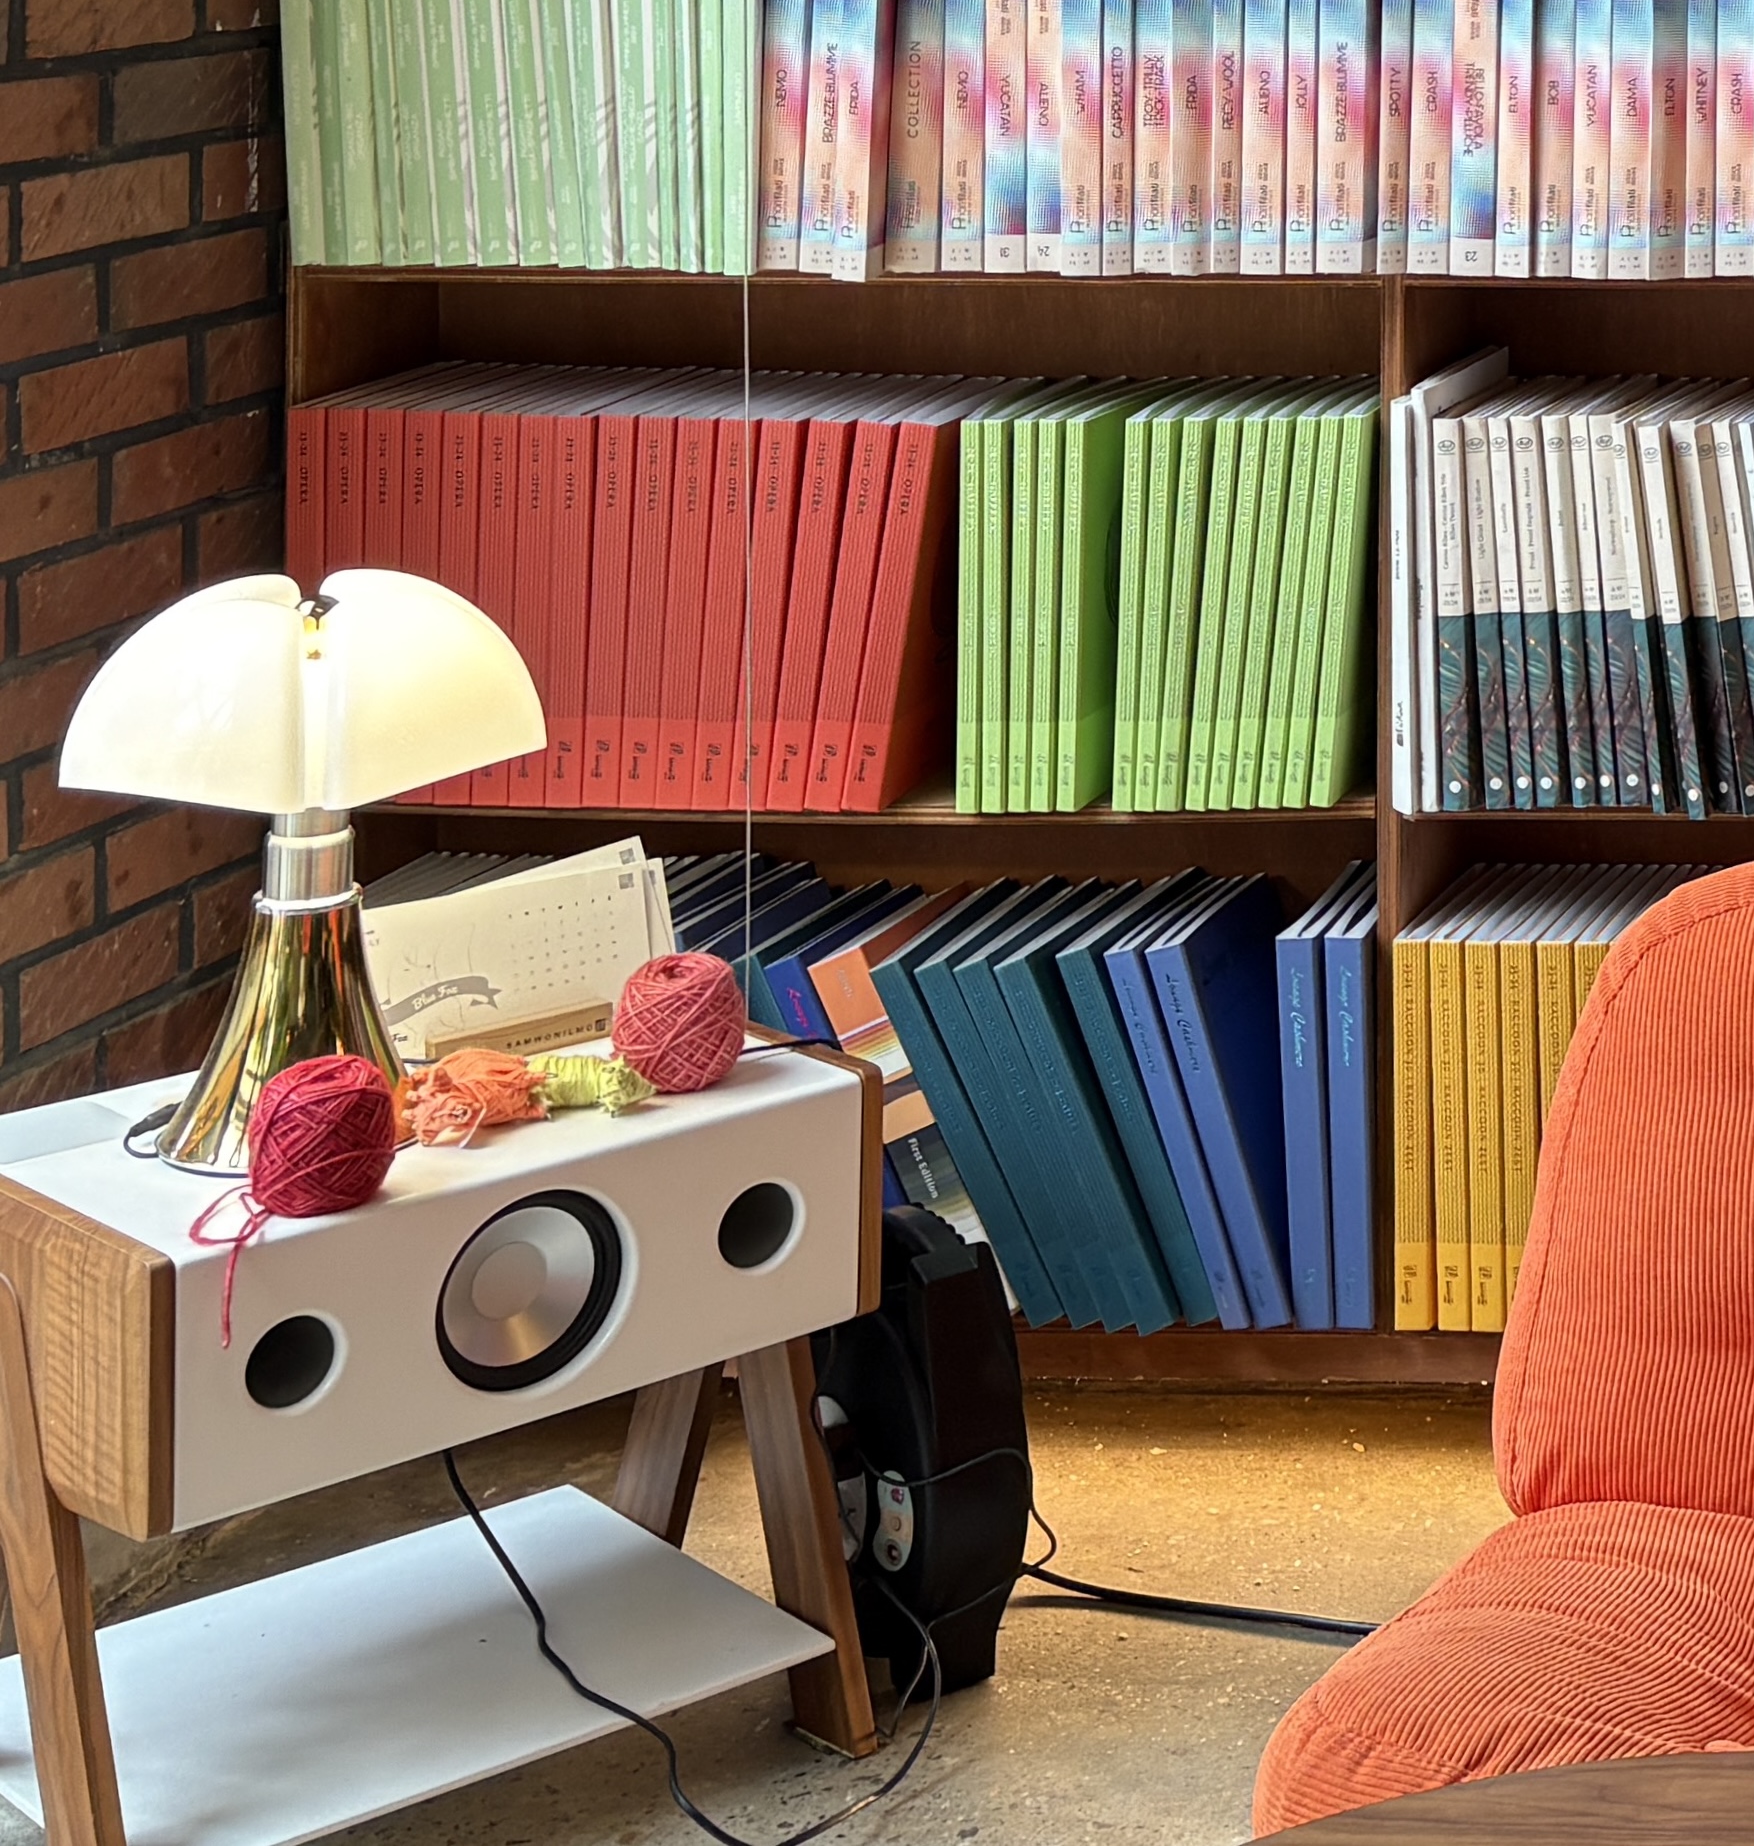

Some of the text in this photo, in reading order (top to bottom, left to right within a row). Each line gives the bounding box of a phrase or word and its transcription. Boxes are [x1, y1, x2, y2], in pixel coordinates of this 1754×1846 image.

[775, 68, 787, 108] NEMO
[848, 80, 861, 116] FRIDA
[907, 40, 921, 139] COLLECTION
[998, 74, 1011, 138] YUCATAN
[1074, 70, 1086, 115] WHAM
[1110, 46, 1124, 140] CAPPUCCETTO
[1221, 50, 1235, 131] RECY-WOOL
[1295, 74, 1308, 110] JOLLY
[1334, 41, 1348, 143] BRAZZE-BLUMME
[1388, 66, 1402, 118] SPOTTY
[1426, 71, 1439, 113] CRASH
[1507, 75, 1520, 114] ELTON
[1547, 80, 1560, 106] BOB
[1585, 64, 1598, 128] YUCATAN
[1626, 77, 1638, 118] DAMA
[1730, 73, 1743, 115] CRASH
[411, 984, 459, 1011] Blue Fox
[506, 1023, 594, 1050] SAMWONILMO
[906, 1136, 939, 1200] First Edition
